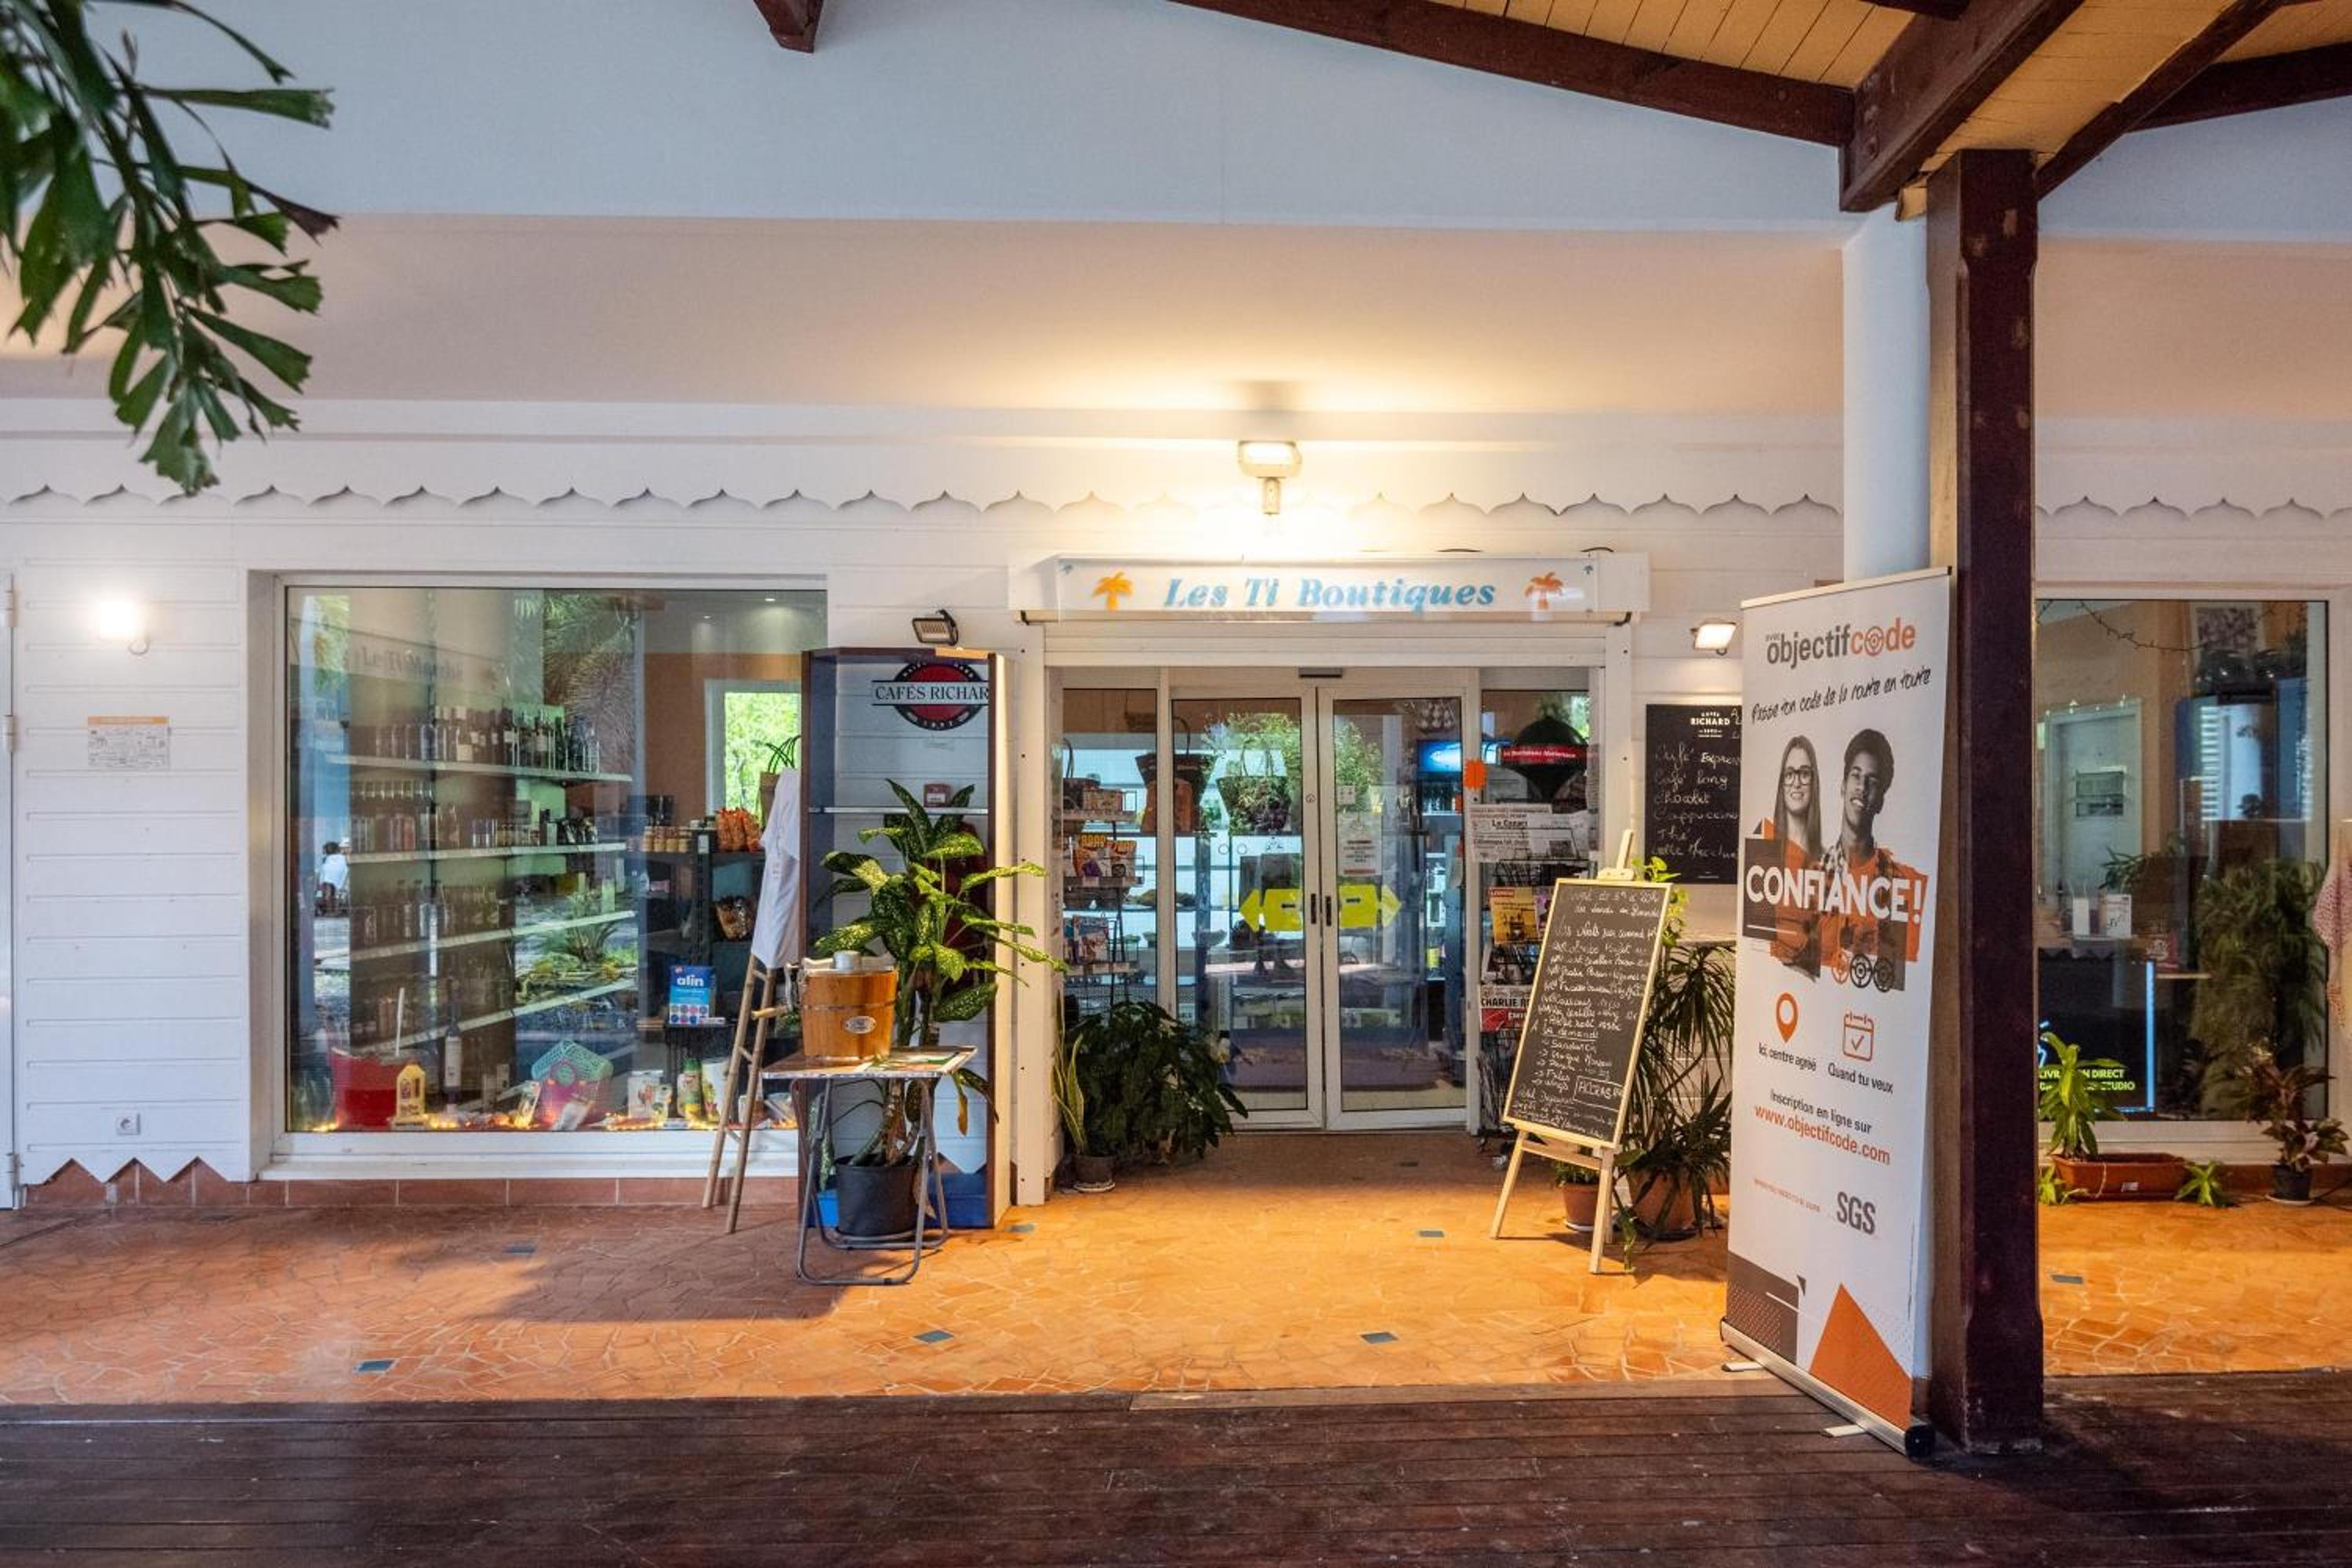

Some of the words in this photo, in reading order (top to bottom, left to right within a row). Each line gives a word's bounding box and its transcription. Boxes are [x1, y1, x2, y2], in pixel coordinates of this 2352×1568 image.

[1163, 578, 1228, 607] Les
[1245, 577, 1279, 607] Ti
[1298, 578, 1496, 613] Boutiques
[931, 686, 989, 700] RICHAR
[1751, 702, 1778, 724] Passe
[1799, 690, 1821, 712] code
[1823, 686, 1835, 706] de
[1884, 676, 1896, 693] en
[1690, 717, 1730, 726] RICHARD
[1746, 865, 1922, 924] CONFIANCE!
[1481, 998, 1519, 1007] CHARLIE
[1769, 1048, 1794, 1064] centre
[1828, 1062, 1856, 1083] Quand
[1859, 1073, 1869, 1085] tu
[1871, 1076, 1893, 1094] veux
[2092, 1069, 2125, 1078] DIRECT
[1770, 1090, 1813, 1114] Inscription
[1817, 1107, 1828, 1118] en
[1831, 1109, 1853, 1127] ligne
[1854, 1120, 1872, 1134] sur
[1755, 1106, 1890, 1164] www.objectifcode.com
[1836, 1191, 1876, 1235] SGS
